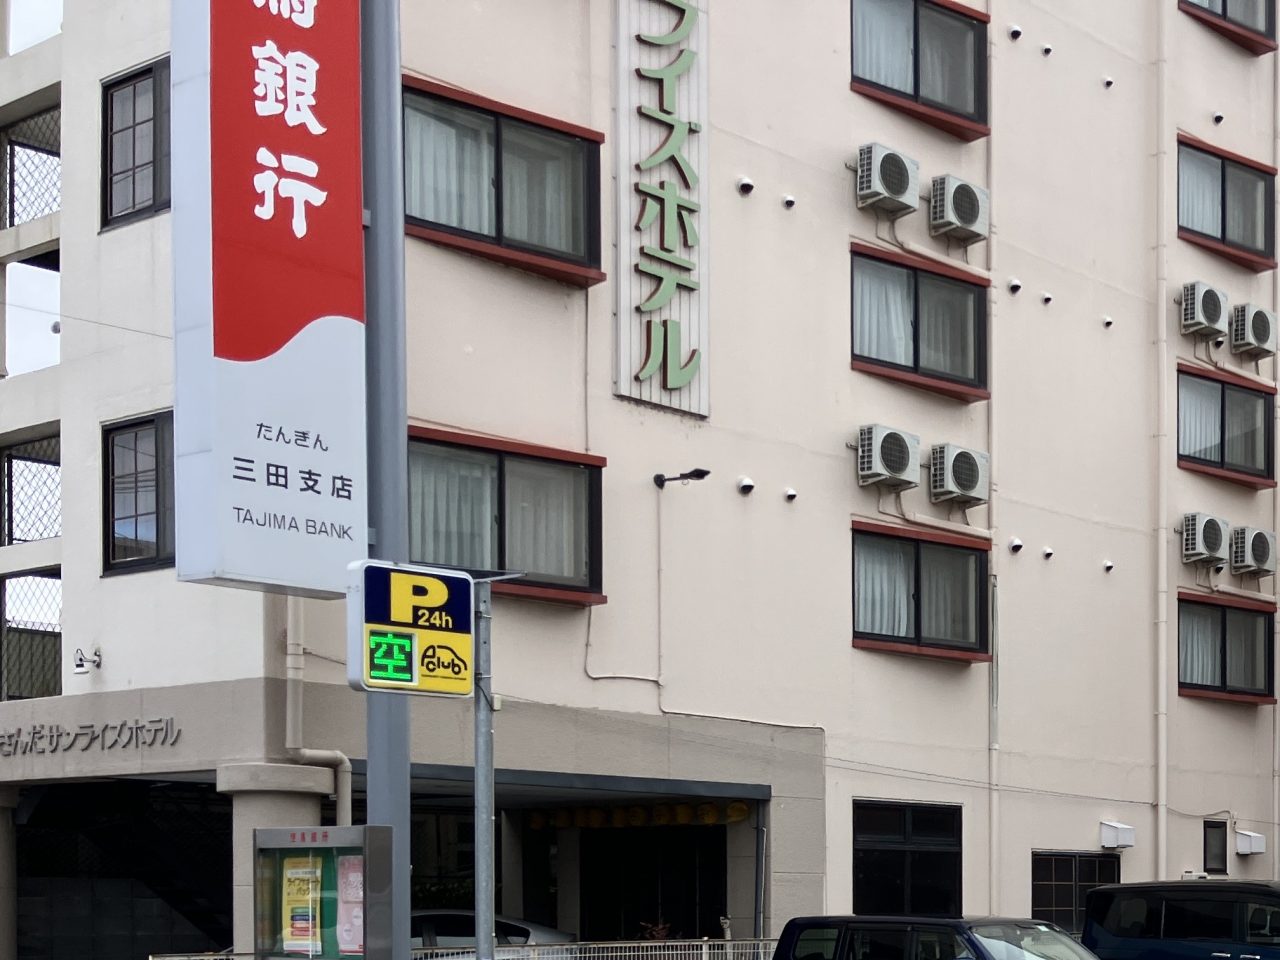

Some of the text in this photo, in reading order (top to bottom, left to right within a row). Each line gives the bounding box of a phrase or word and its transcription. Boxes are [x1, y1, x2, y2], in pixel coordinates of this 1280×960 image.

[256, 422, 329, 452] たんぎん
[232, 456, 353, 500] 三田支店
[232, 506, 354, 541] TAJIMA BANK
[390, 571, 449, 624] P
[417, 609, 453, 629] 24h
[369, 632, 412, 680] 空
